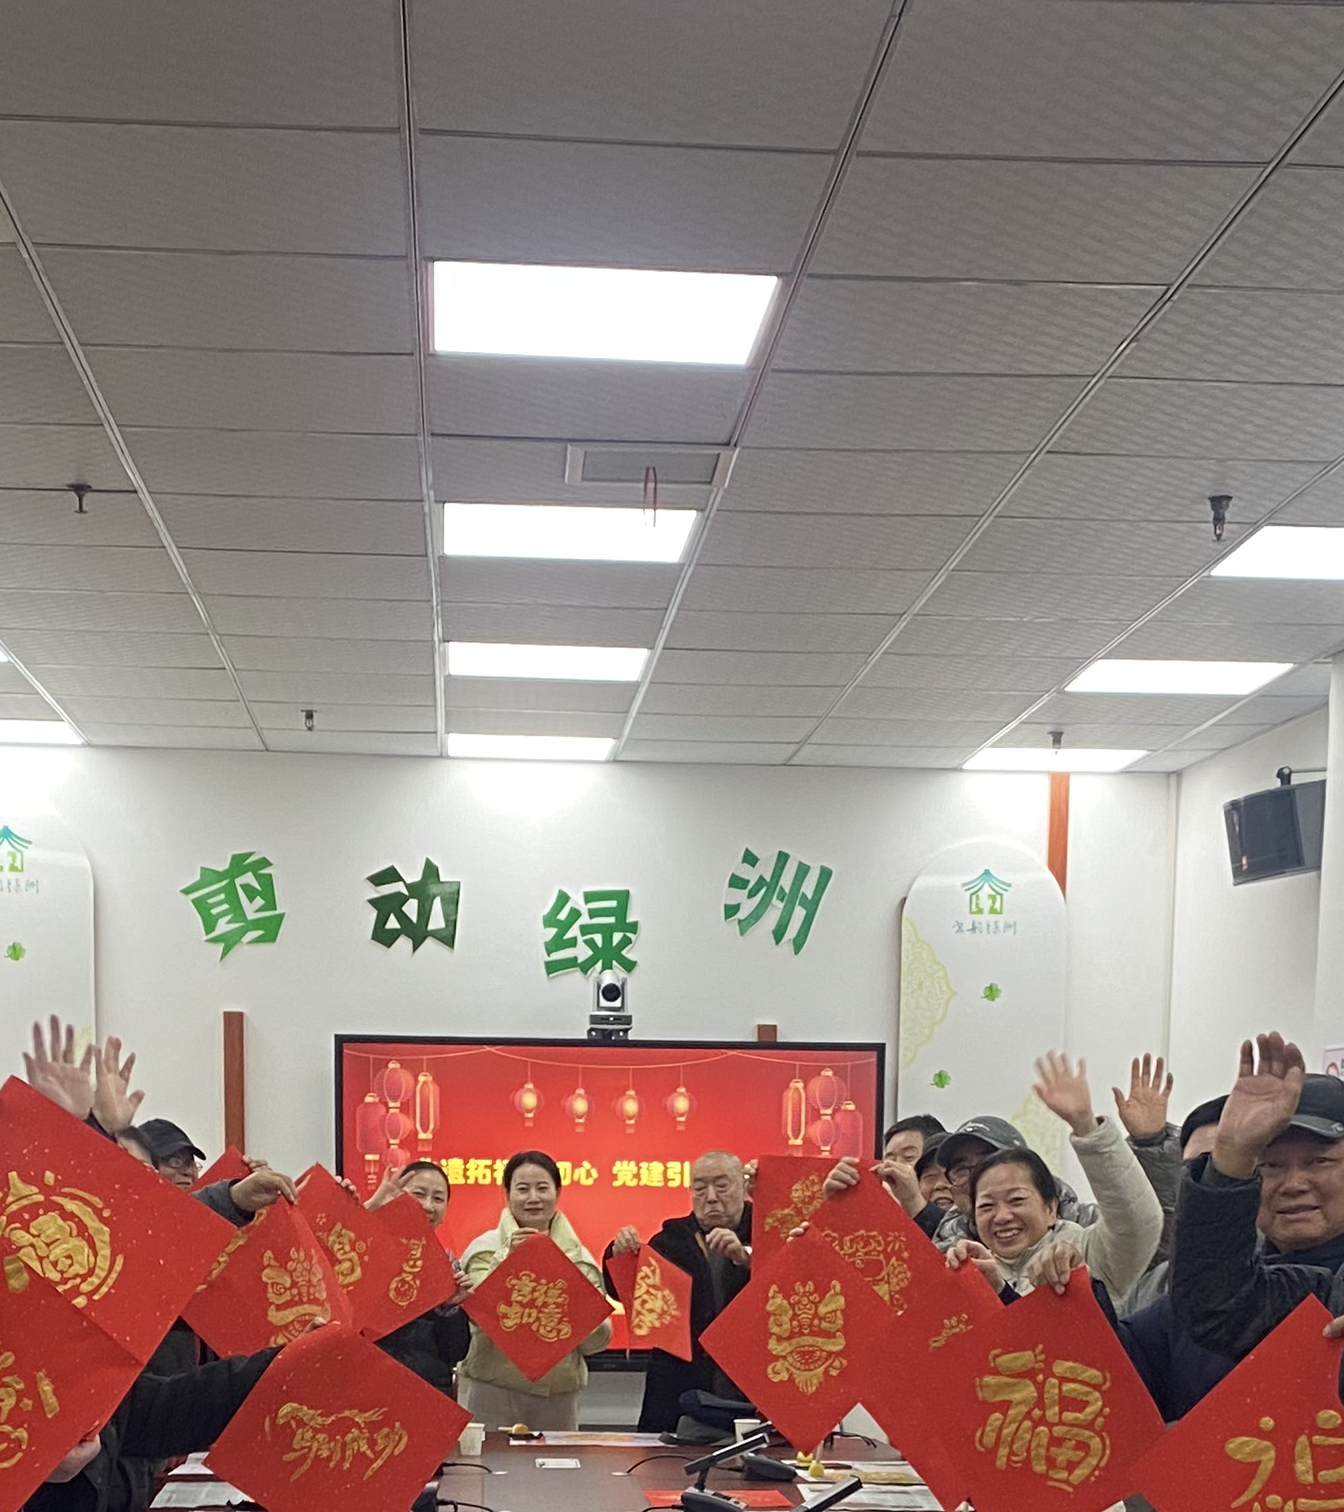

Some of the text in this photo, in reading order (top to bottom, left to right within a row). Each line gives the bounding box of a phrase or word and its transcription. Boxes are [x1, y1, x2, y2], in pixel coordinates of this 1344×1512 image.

[179, 846, 834, 979] 剪动绿洲
[976, 1345, 1111, 1491] 福
